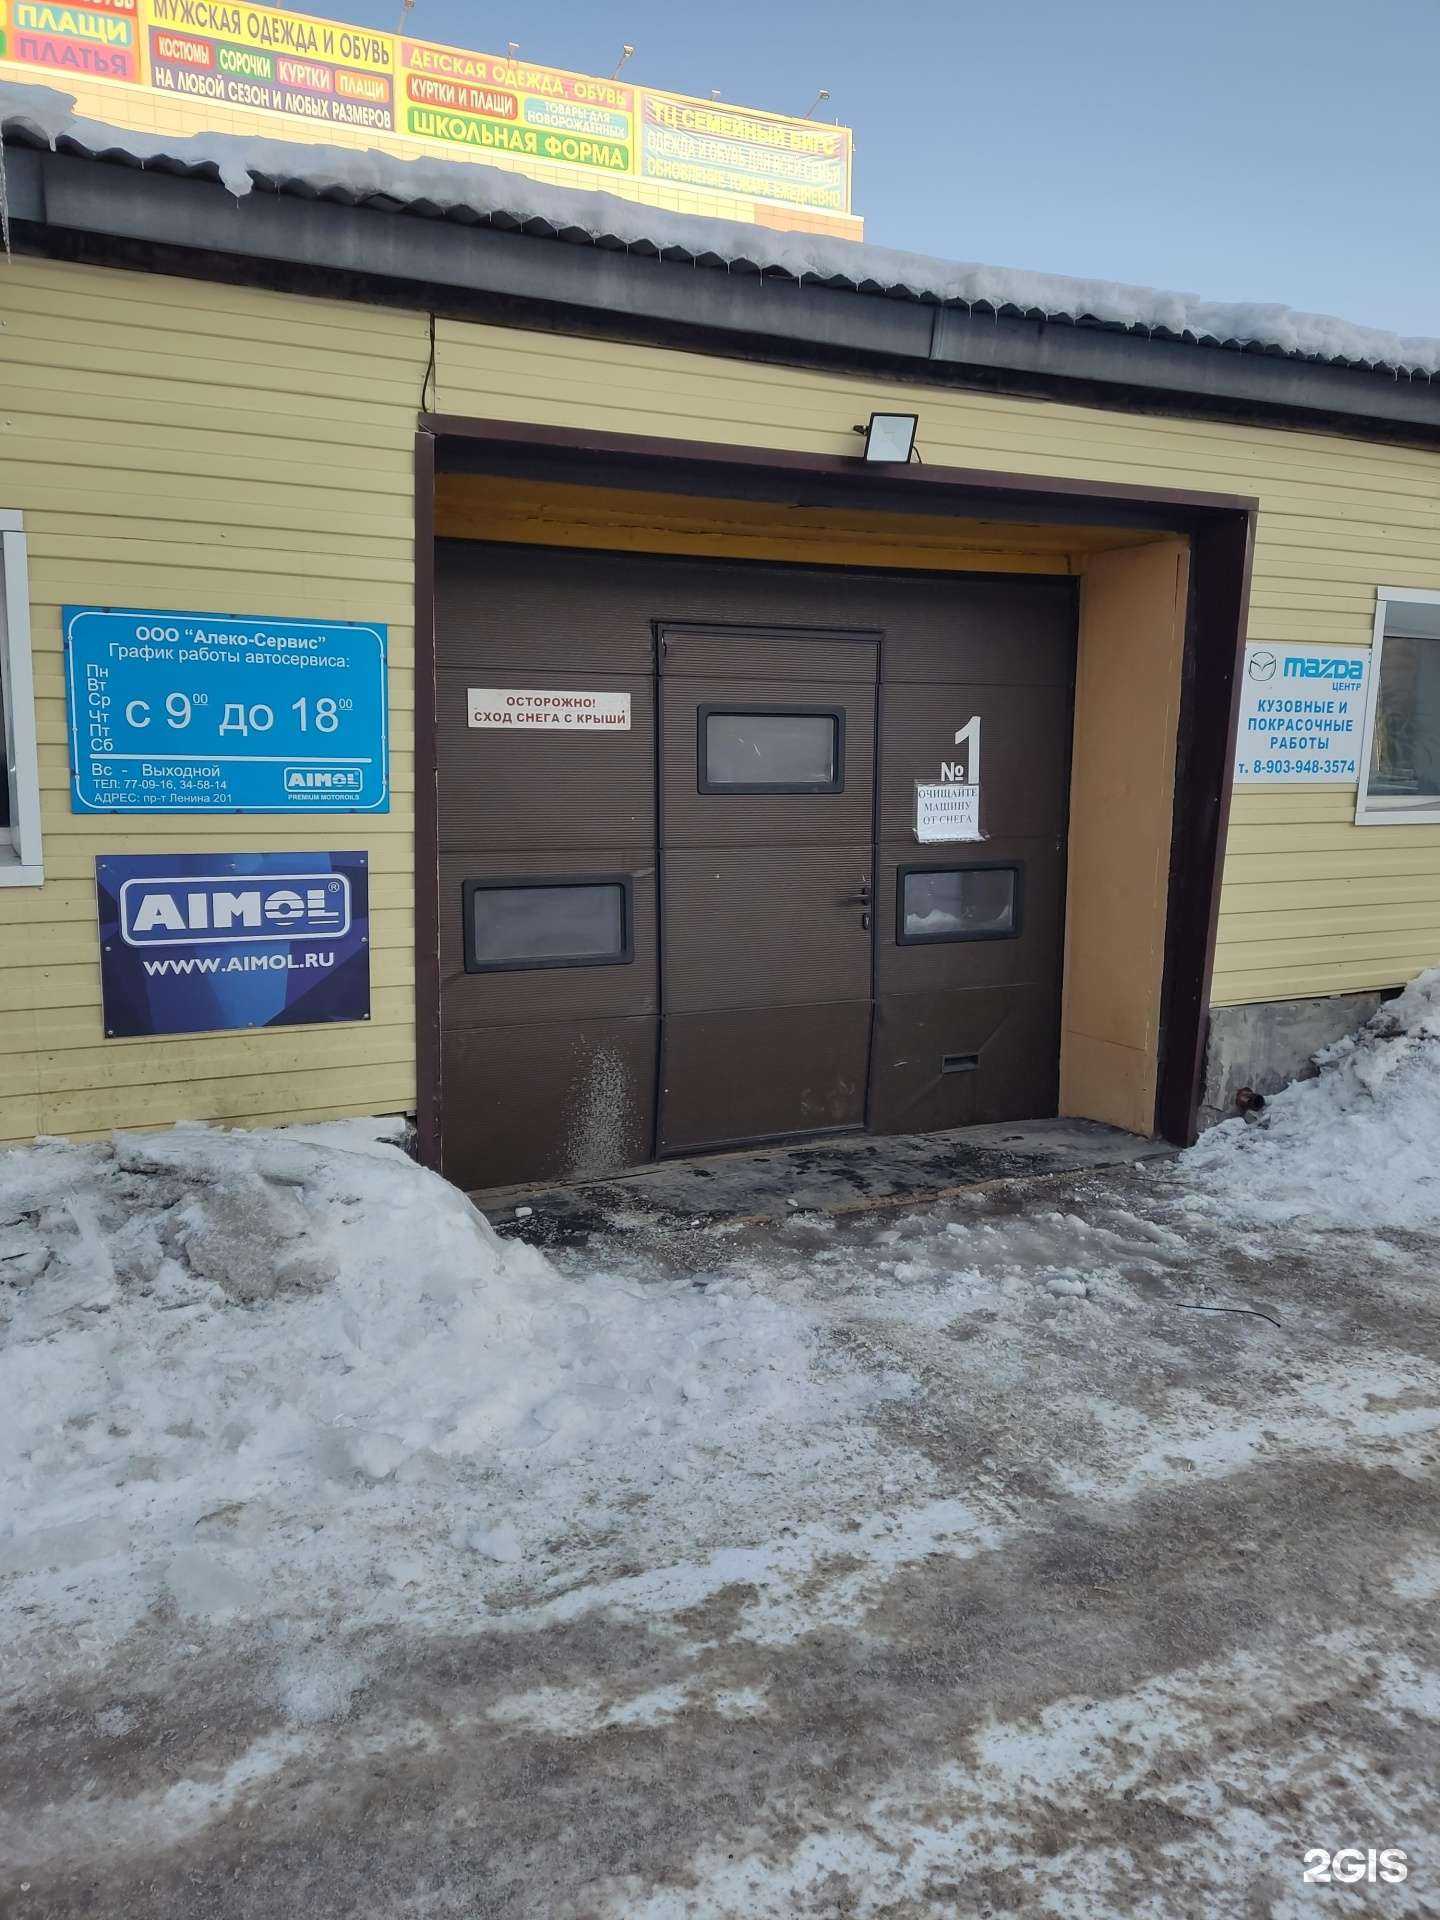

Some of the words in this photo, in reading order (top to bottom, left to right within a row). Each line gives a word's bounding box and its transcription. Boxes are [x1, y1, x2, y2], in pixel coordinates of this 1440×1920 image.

[17, 4, 127, 44] ПЛАЩИ
[154, 0, 241, 34] МУЖСКАЯ
[247, 13, 317, 51] ОДЕЖДА
[323, 28, 334, 54] И
[340, 33, 389, 65] ОБУВЬ
[20, 38, 128, 76] ПЛАТЬЯ
[158, 36, 210, 64] КОСТЮМЫ
[219, 48, 271, 78] СОРОЧКИ
[279, 61, 331, 90] КУРТКИ
[340, 75, 384, 100] ПЛАЩИ
[410, 48, 487, 78] ДЕТСКАЯ
[574, 82, 627, 106] ОБУВЬ
[155, 67, 174, 89] НА
[177, 73, 224, 99] ЛЮБОЙ
[228, 82, 270, 107] СЕЗОН
[272, 91, 282, 109] И
[285, 94, 329, 119] ЛЮБЫХ
[332, 102, 391, 128] РАЗМЕРОВ
[411, 77, 454, 103] КУРТКИ
[458, 90, 467, 105] И
[470, 90, 513, 115] ПЛАЩИ
[543, 101, 588, 120] ТОВАРЫ
[413, 111, 537, 151] ШКОЛЬНАЯ
[544, 135, 624, 168] ФОРМА
[135, 626, 180, 642] ООО
[109, 643, 174, 662] График
[179, 646, 240, 664] работы
[245, 653, 350, 668] автосервиса:
[87, 664, 109, 678] Пн
[87, 679, 106, 692] Вт
[1332, 682, 1362, 692] ЦЕНТР
[88, 693, 111, 708] Ср
[506, 696, 596, 708] ОСТОРОЖНО!
[1258, 699, 1334, 714] КУЗОВНЫЕ
[1339, 702, 1348, 714] И
[89, 710, 109, 723] Чт
[219, 703, 274, 736] до
[474, 711, 512, 724] СХОД
[517, 712, 560, 723] СНЕГА
[564, 712, 572, 723] С
[577, 712, 626, 724] КРЫШИ
[90, 724, 110, 737] Пт
[1248, 718, 1354, 732] ПОКРАСОЧНЫЕ
[90, 738, 114, 752] Сб
[954, 715, 981, 784] 1
[1270, 736, 1329, 750] РАБОТЫ
[92, 763, 112, 777] Вс
[142, 763, 220, 778] Выходной
[1253, 760, 1355, 774] 8-903-948-3574
[93, 779, 121, 790] ТЕЛ:
[124, 780, 176, 791] 77-09-16,
[179, 780, 227, 790] 34-58-14
[94, 792, 140, 804] АДРЕС:
[143, 794, 168, 805] пр-т
[169, 792, 210, 804] Ленина
[213, 793, 232, 804] 201
[923, 814, 936, 825] ОТ
[940, 813, 972, 824] СНЕГА
[143, 952, 335, 977] WWW.AIMOL.RU
